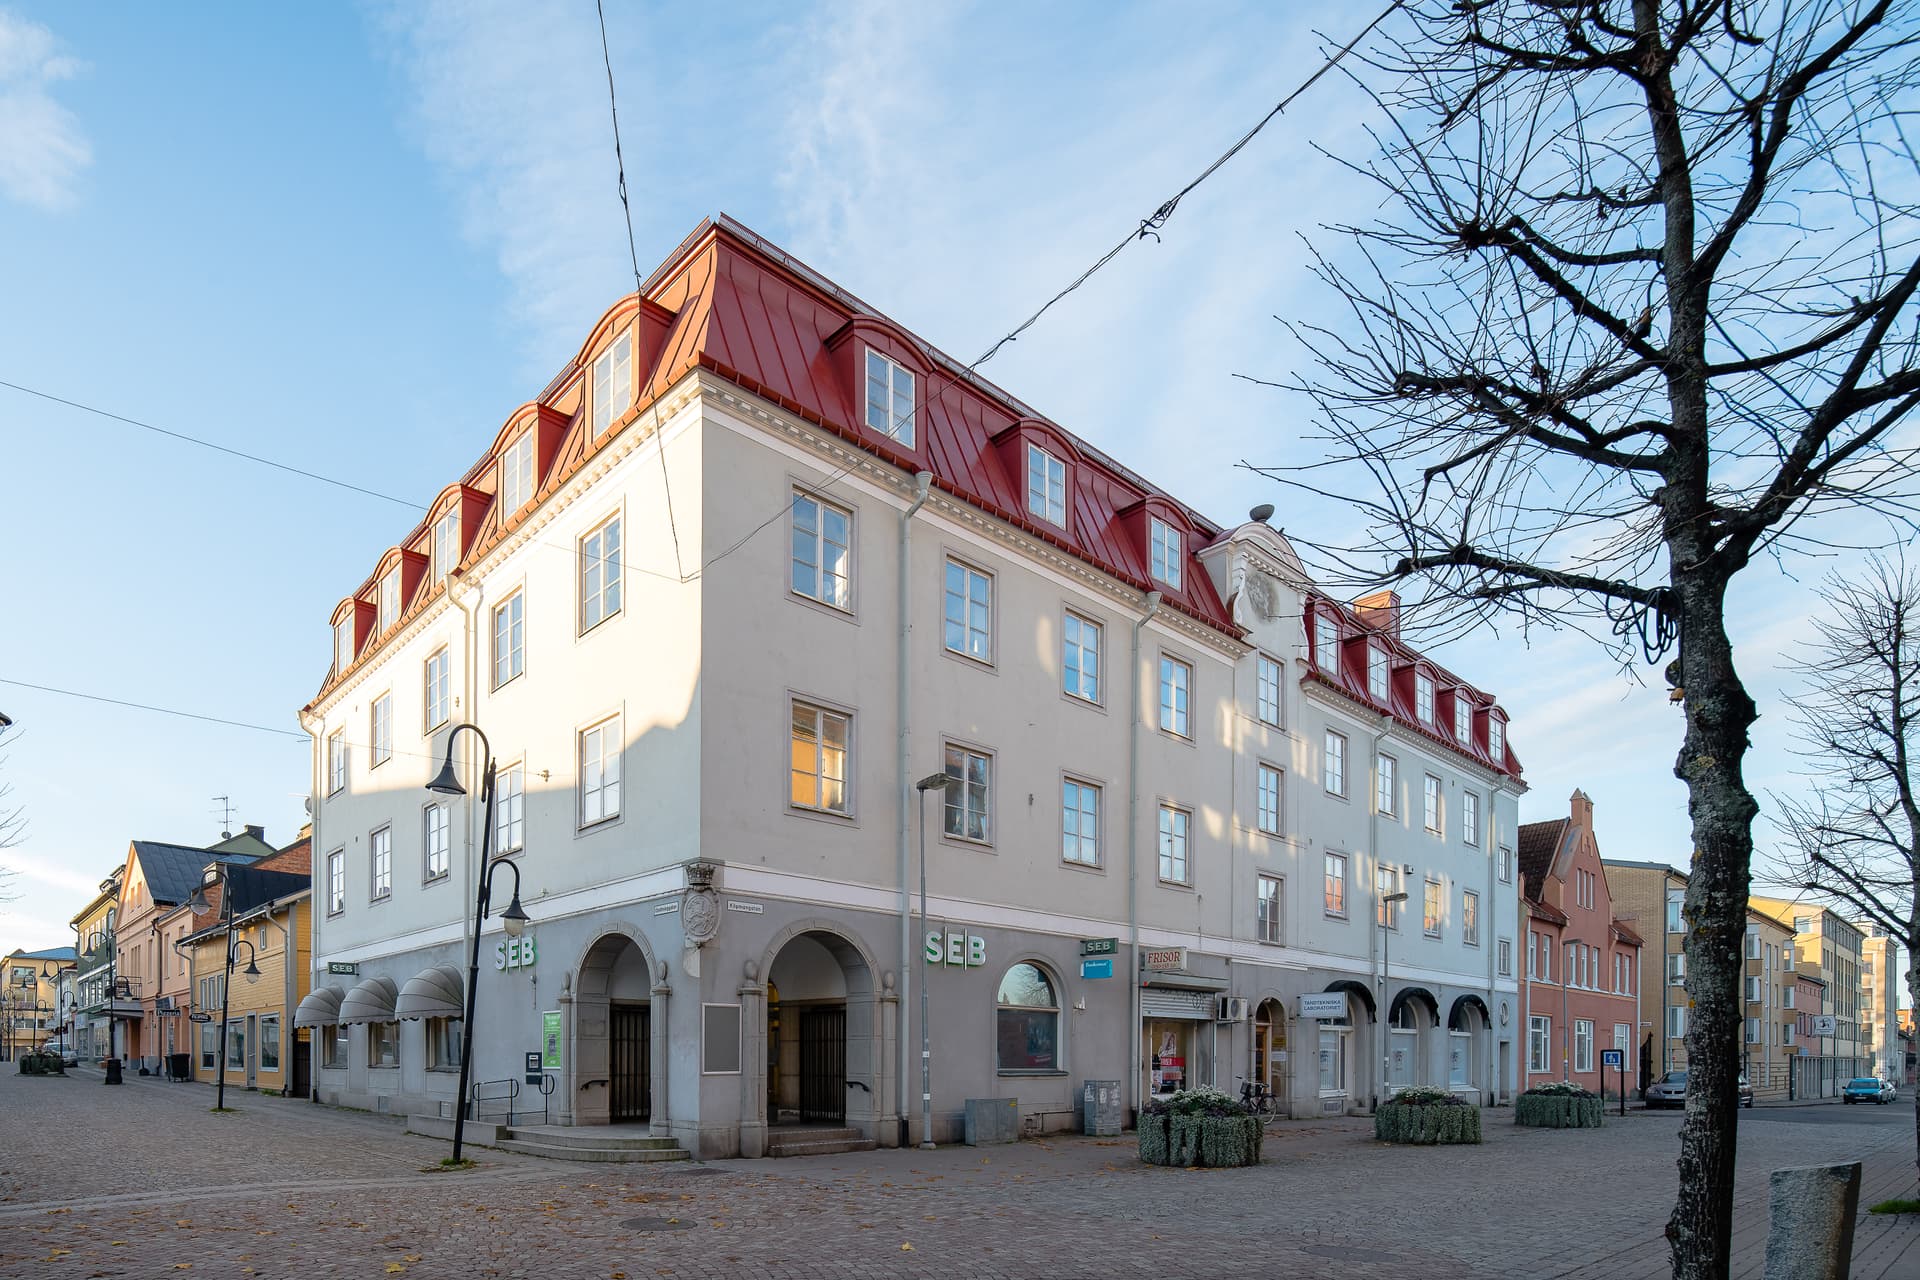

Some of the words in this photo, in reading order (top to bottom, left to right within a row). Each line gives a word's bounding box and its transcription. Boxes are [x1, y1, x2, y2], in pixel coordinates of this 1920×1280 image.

[495, 936, 536, 970] SEB
[926, 931, 986, 966] SEB
[1087, 941, 1111, 952] SEB
[331, 964, 353, 973] SEB
